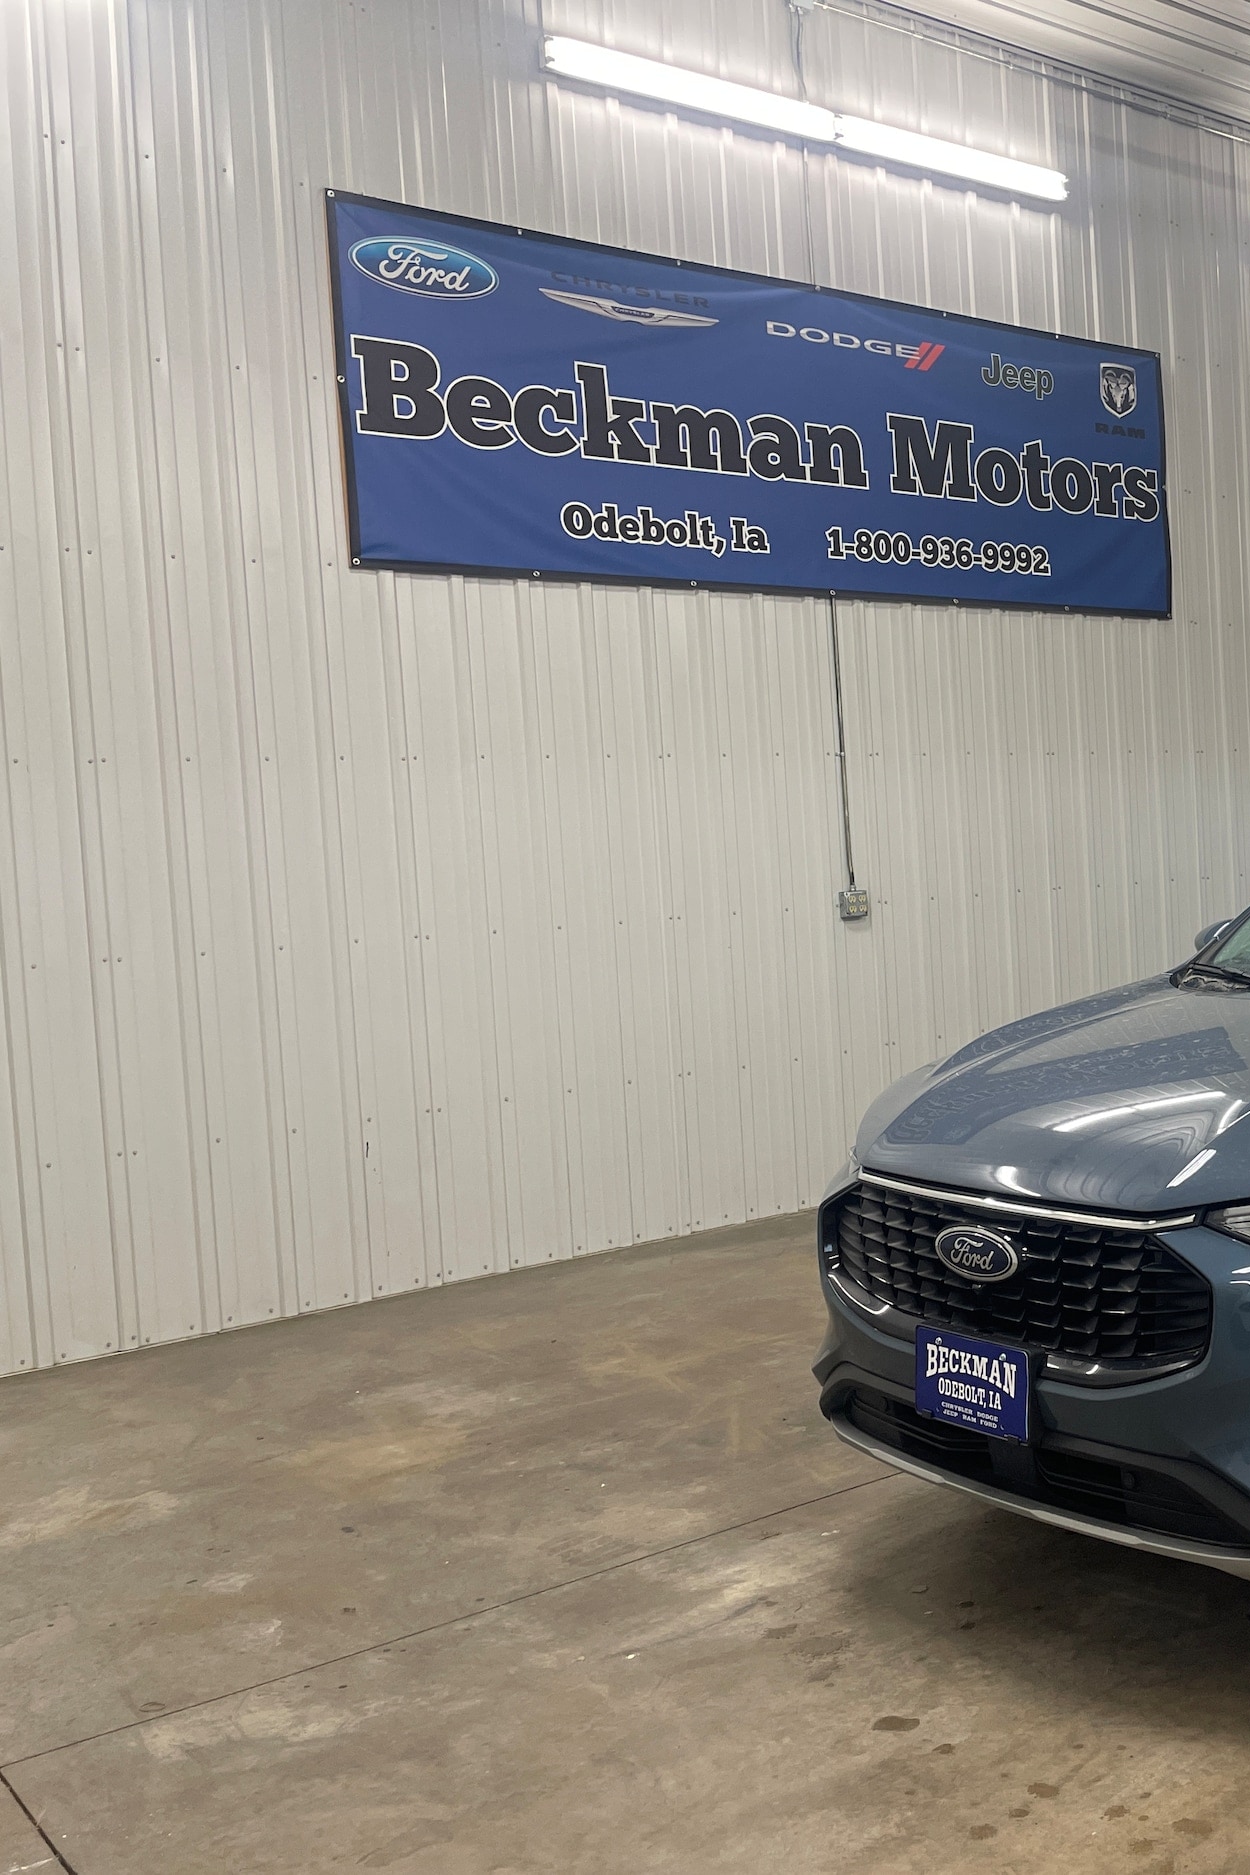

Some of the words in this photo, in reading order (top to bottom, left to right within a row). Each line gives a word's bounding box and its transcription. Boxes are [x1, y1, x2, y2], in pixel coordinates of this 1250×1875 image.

[378, 244, 470, 292] Ford
[550, 270, 710, 308] CHRYSLER
[766, 320, 920, 358] DODGE
[981, 353, 1053, 400] Jeep
[350, 333, 869, 490] Beckman
[886, 412, 1160, 522] Motors
[1094, 422, 1146, 439] RAM
[560, 500, 726, 558] Odebolt,
[730, 517, 770, 554] Ia
[825, 526, 1052, 576] 1-800-936-9992
[951, 1236, 994, 1271] Ford
[925, 1343, 1017, 1399] BECKMAN
[938, 1377, 986, 1408] ODEBOLT,
[989, 1391, 1002, 1410] IA
[941, 1401, 973, 1415] CHRYSLER
[977, 1411, 999, 1422] DODGE
[943, 1408, 959, 1417] JEEP
[962, 1414, 977, 1423] RAM
[980, 1418, 997, 1429] FORD
